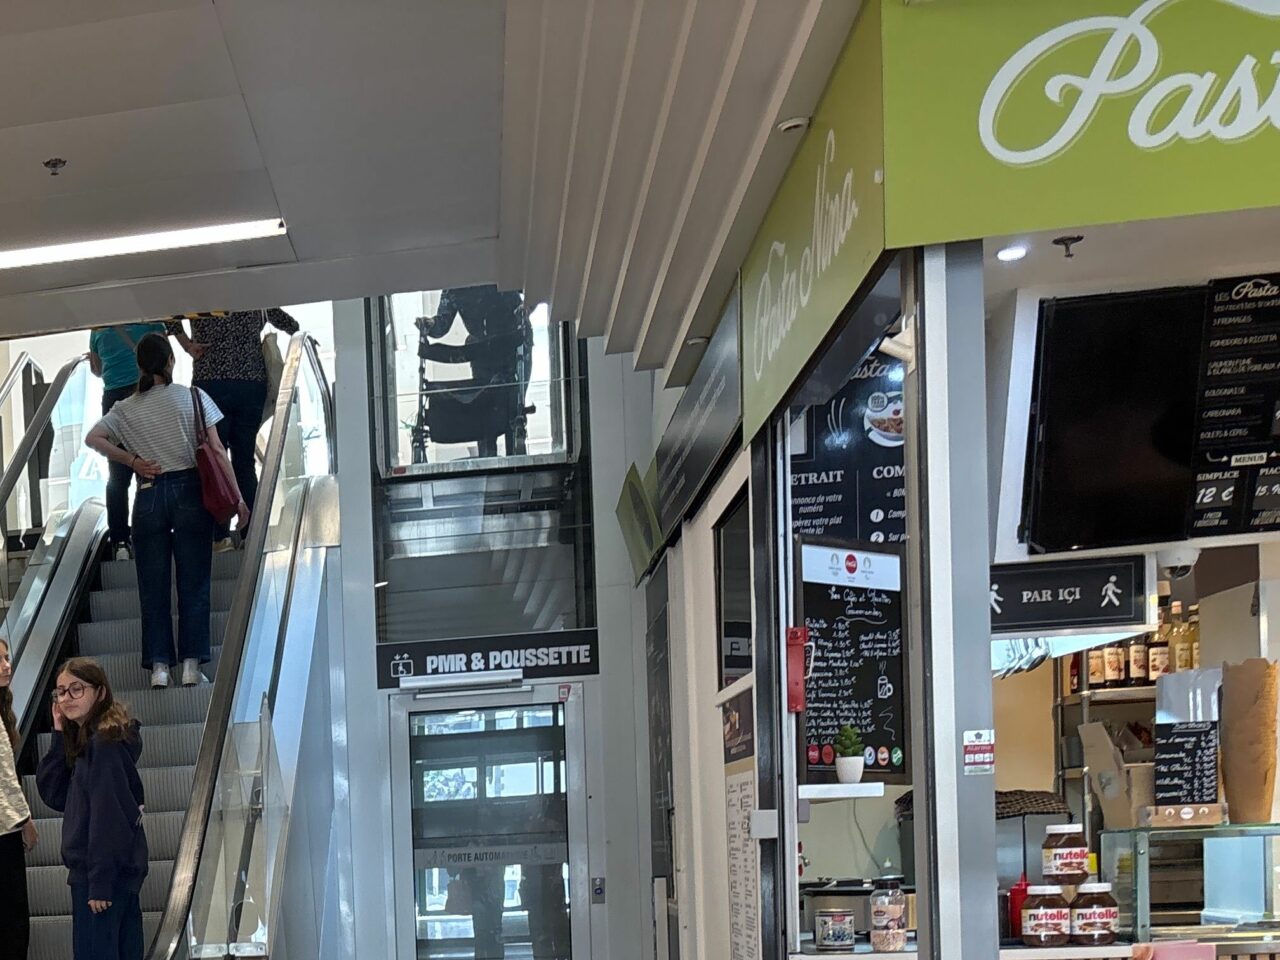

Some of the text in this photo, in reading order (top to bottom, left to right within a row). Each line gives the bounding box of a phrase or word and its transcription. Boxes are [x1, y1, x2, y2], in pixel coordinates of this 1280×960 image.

[1231, 278, 1280, 300] Pasta
[754, 241, 798, 382] Pasta
[791, 470, 844, 486] ETRAIT
[825, 493, 842, 502] votre
[1196, 486, 1235, 504] 12 €
[799, 504, 823, 514] numéro
[812, 517, 828, 526] votre
[829, 515, 842, 525] plat
[1022, 589, 1052, 603] PAR
[426, 644, 591, 674] PMR & POUSSETTE
[448, 852, 472, 862] PORTE
